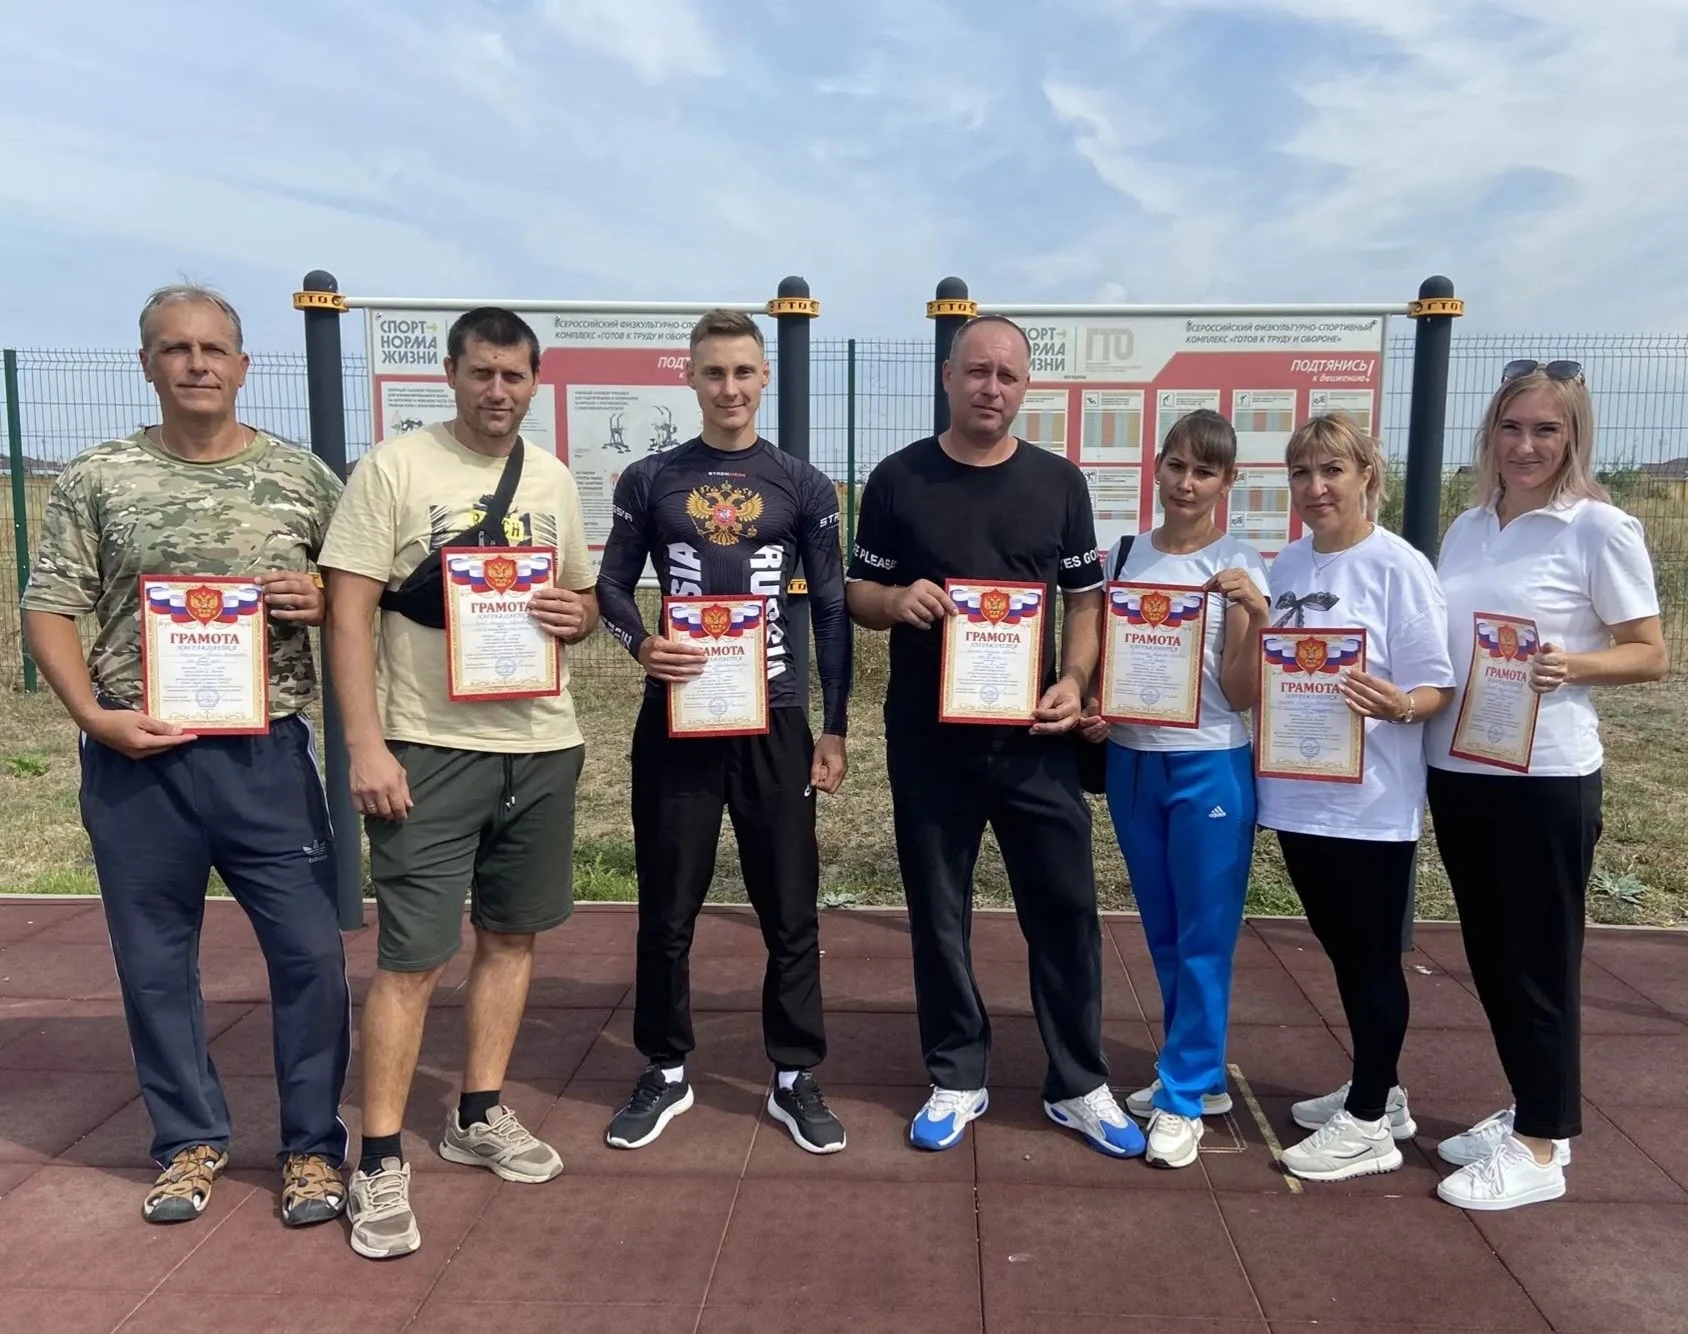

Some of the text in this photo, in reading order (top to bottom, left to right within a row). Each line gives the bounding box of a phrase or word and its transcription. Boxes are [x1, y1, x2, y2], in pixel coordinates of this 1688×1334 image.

[380, 320, 427, 334] СПОРТ
[620, 321, 697, 329] ФИЗКУЛЬТУРНО-СПО
[555, 331, 596, 339] КОМПЛЕКС
[1021, 327, 1057, 341] ОРТ
[1186, 335, 1228, 343] КОМПЛЕКС
[1267, 335, 1292, 343] ТРУДУ
[1293, 335, 1300, 343] И
[381, 335, 437, 349] НОРМА
[1032, 342, 1066, 356] РМА
[1086, 328, 1134, 361] ГТО
[382, 351, 438, 365] ЖИЗНИ
[1030, 357, 1065, 371] ИЗНИ
[820, 512, 840, 528] STR
[471, 601, 532, 613] ГРАМОТА
[170, 633, 240, 645] ГРАМОТА
[965, 631, 1021, 644] ГРАМОТА
[1124, 632, 1181, 646] ГРАМОТА
[700, 645, 745, 656] АМОТА
[1485, 666, 1527, 682] ГРАМОТА
[1281, 681, 1340, 694] ГРАМОТА
